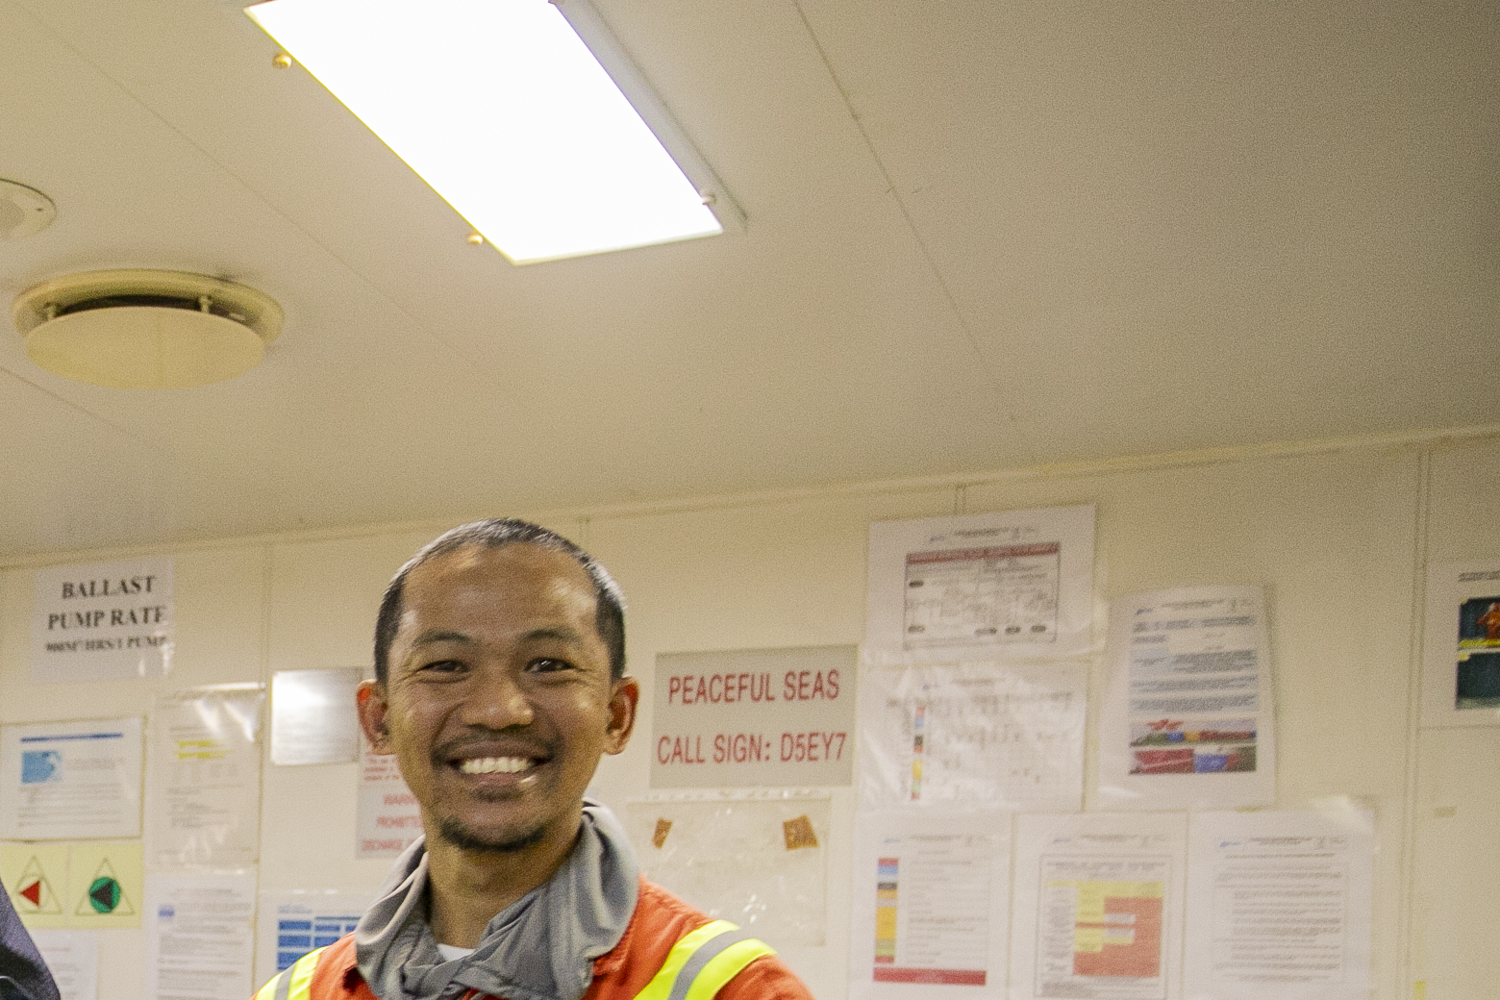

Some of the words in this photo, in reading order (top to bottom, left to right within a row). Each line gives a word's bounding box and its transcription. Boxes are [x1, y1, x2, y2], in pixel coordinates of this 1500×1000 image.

[61, 575, 156, 599] BALLAST
[47, 609, 106, 630] PUMP
[110, 604, 167, 626] RATE
[668, 672, 776, 705] PEACEFUL
[783, 668, 840, 702] SEAS
[656, 734, 706, 765] CALL
[712, 732, 771, 764] SIGN:
[780, 731, 848, 763] D5EY7
